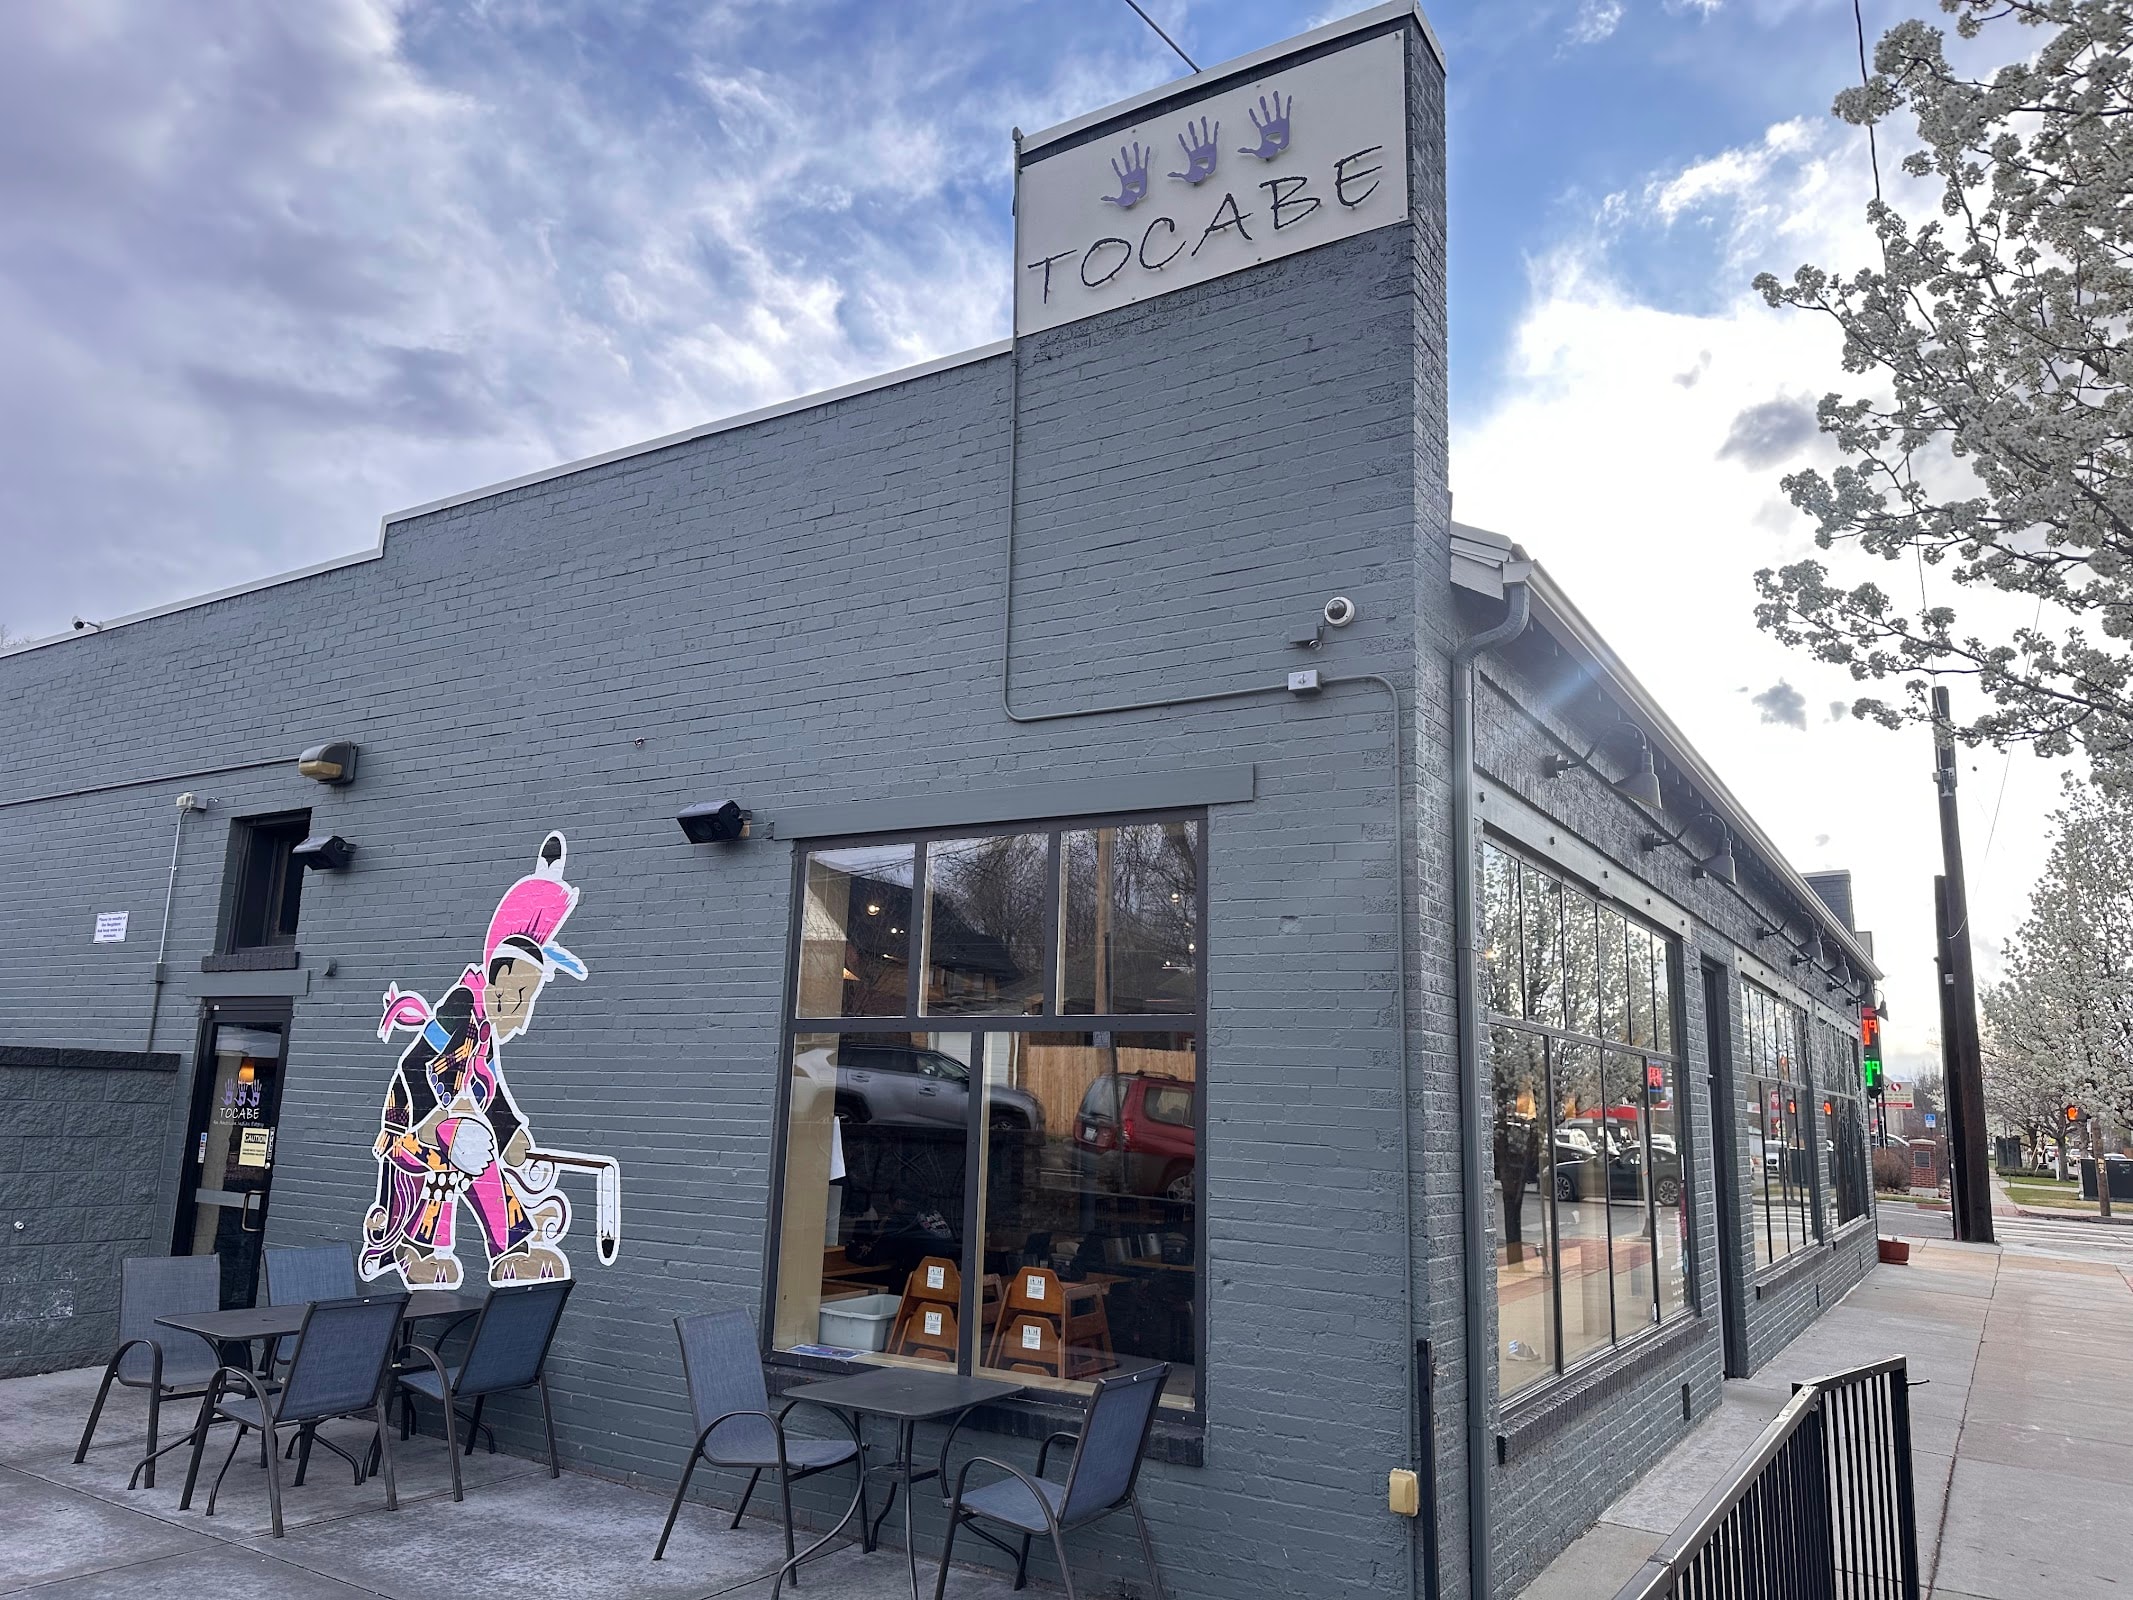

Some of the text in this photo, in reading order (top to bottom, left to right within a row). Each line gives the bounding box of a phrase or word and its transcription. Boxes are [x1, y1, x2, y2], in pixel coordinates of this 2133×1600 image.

[1028, 145, 1382, 304] TOCABE
[220, 1108, 260, 1119] TOCABE
[245, 1134, 266, 1143] CAUTION
